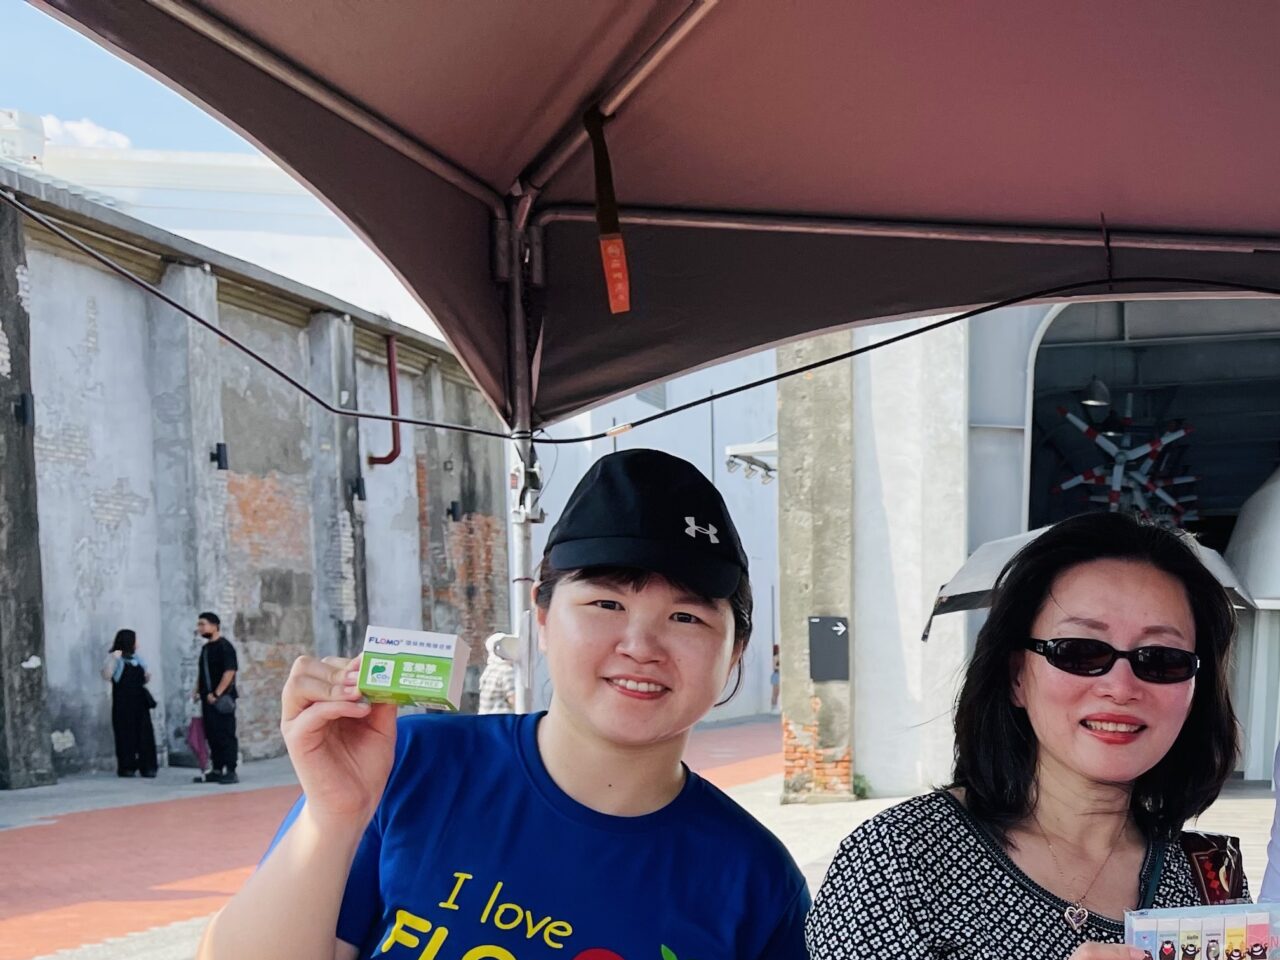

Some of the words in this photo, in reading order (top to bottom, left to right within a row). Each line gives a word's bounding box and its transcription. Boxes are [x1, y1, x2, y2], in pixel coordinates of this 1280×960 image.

[368, 636, 400, 646] FLOMO
[438, 871, 473, 911] I
[480, 881, 573, 949] love
